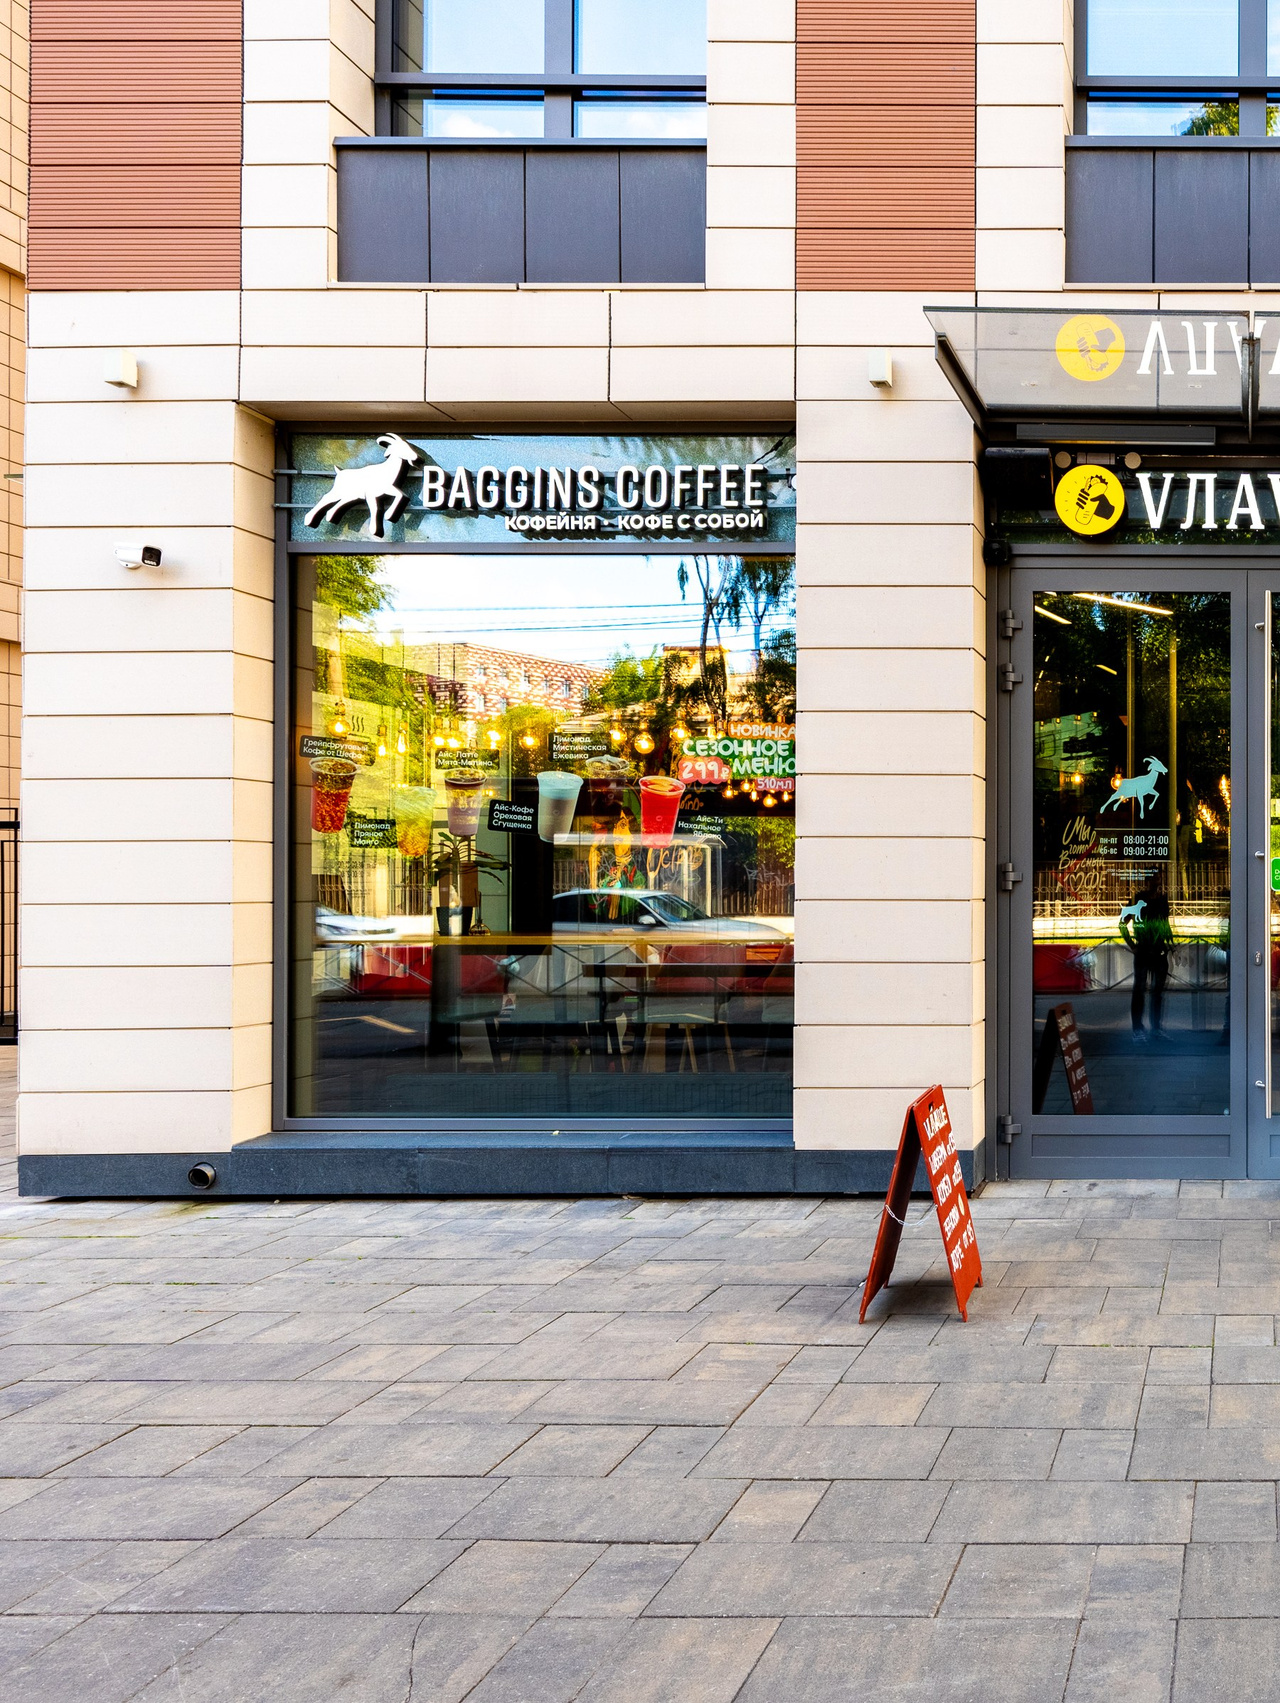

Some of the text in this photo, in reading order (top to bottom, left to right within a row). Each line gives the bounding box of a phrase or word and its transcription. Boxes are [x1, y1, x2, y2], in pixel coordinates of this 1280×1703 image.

[423, 463, 766, 509] BAGGINS COFFEE
[504, 509, 764, 530] КОФЕЙНЯ КОФЕ С СОБОЙ
[730, 723, 796, 739] НОВИНКА
[553, 735, 592, 743] Лимонад
[303, 746, 325, 756] Кофе
[336, 750, 362, 759] Шефа
[553, 743, 607, 751] Мистическая
[682, 739, 791, 757] СЕЗОННОЕ
[733, 757, 796, 775] МЕНЮ
[494, 803, 535, 814] Айс-Кофе
[493, 811, 533, 821] Ореховая
[696, 815, 724, 824] Айс-Ти
[492, 819, 532, 830] Сгущенка
[678, 821, 722, 831] Нахальное
[1062, 816, 1091, 845] Мы
